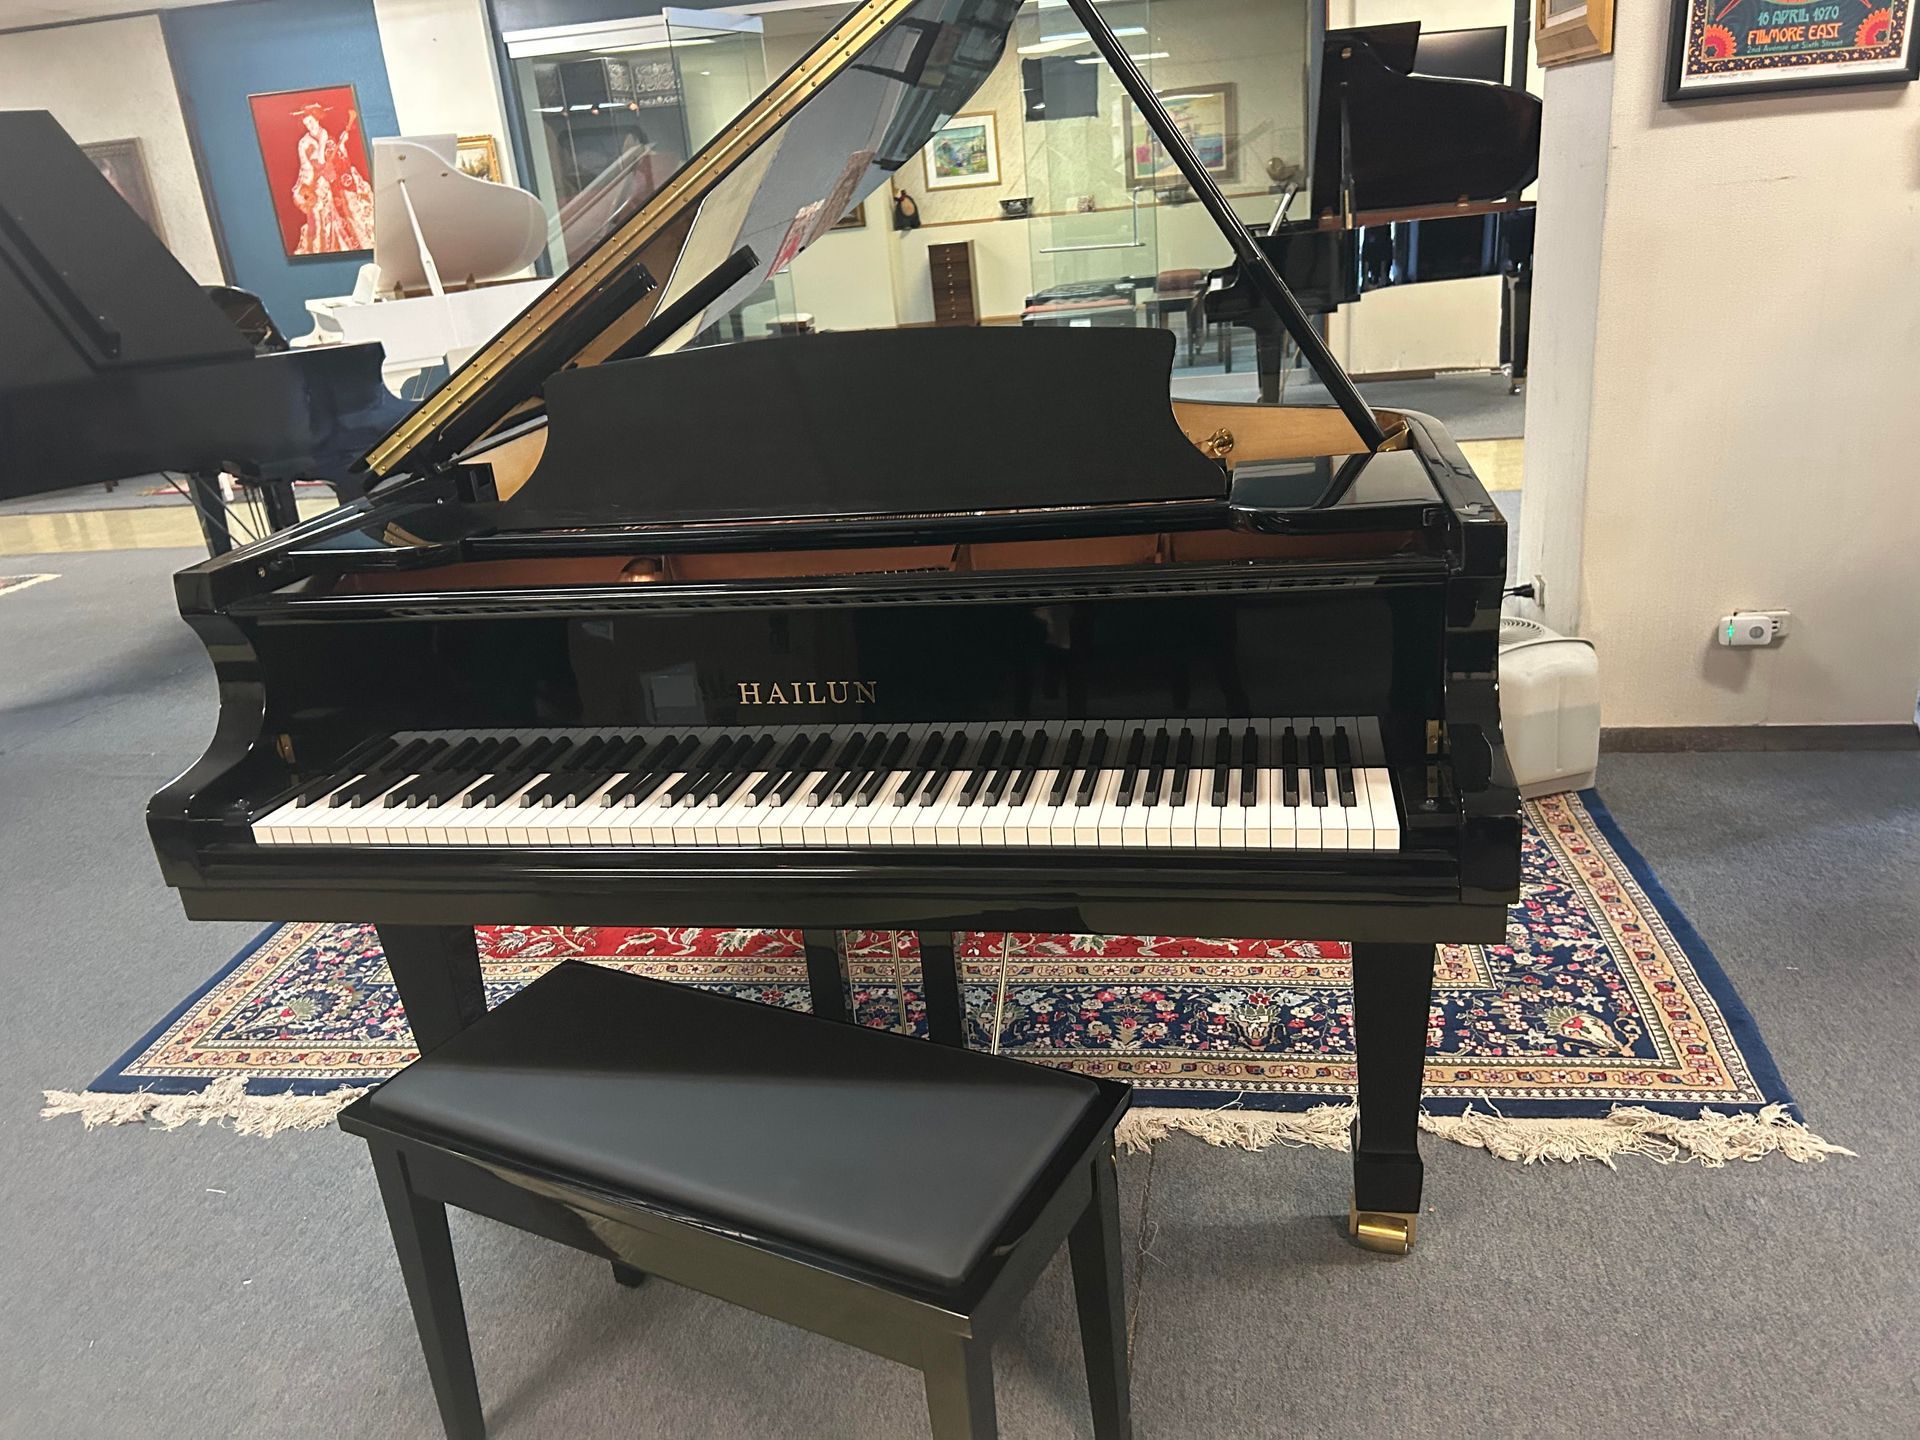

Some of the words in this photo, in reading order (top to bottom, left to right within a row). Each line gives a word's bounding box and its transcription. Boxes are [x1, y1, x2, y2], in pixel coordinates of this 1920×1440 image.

[1758, 12, 1769, 26] 16
[1772, 8, 1809, 25] APRIL
[1813, 6, 1839, 21] 1970
[1747, 26, 1806, 45] FILLMORE
[1808, 22, 1843, 40] EAST
[1747, 45, 1761, 54] 2nd
[1763, 44, 1787, 52] Avenue
[1801, 40, 1819, 49] Sixth
[1822, 39, 1843, 47] Street
[737, 681, 877, 705] HAILUN
